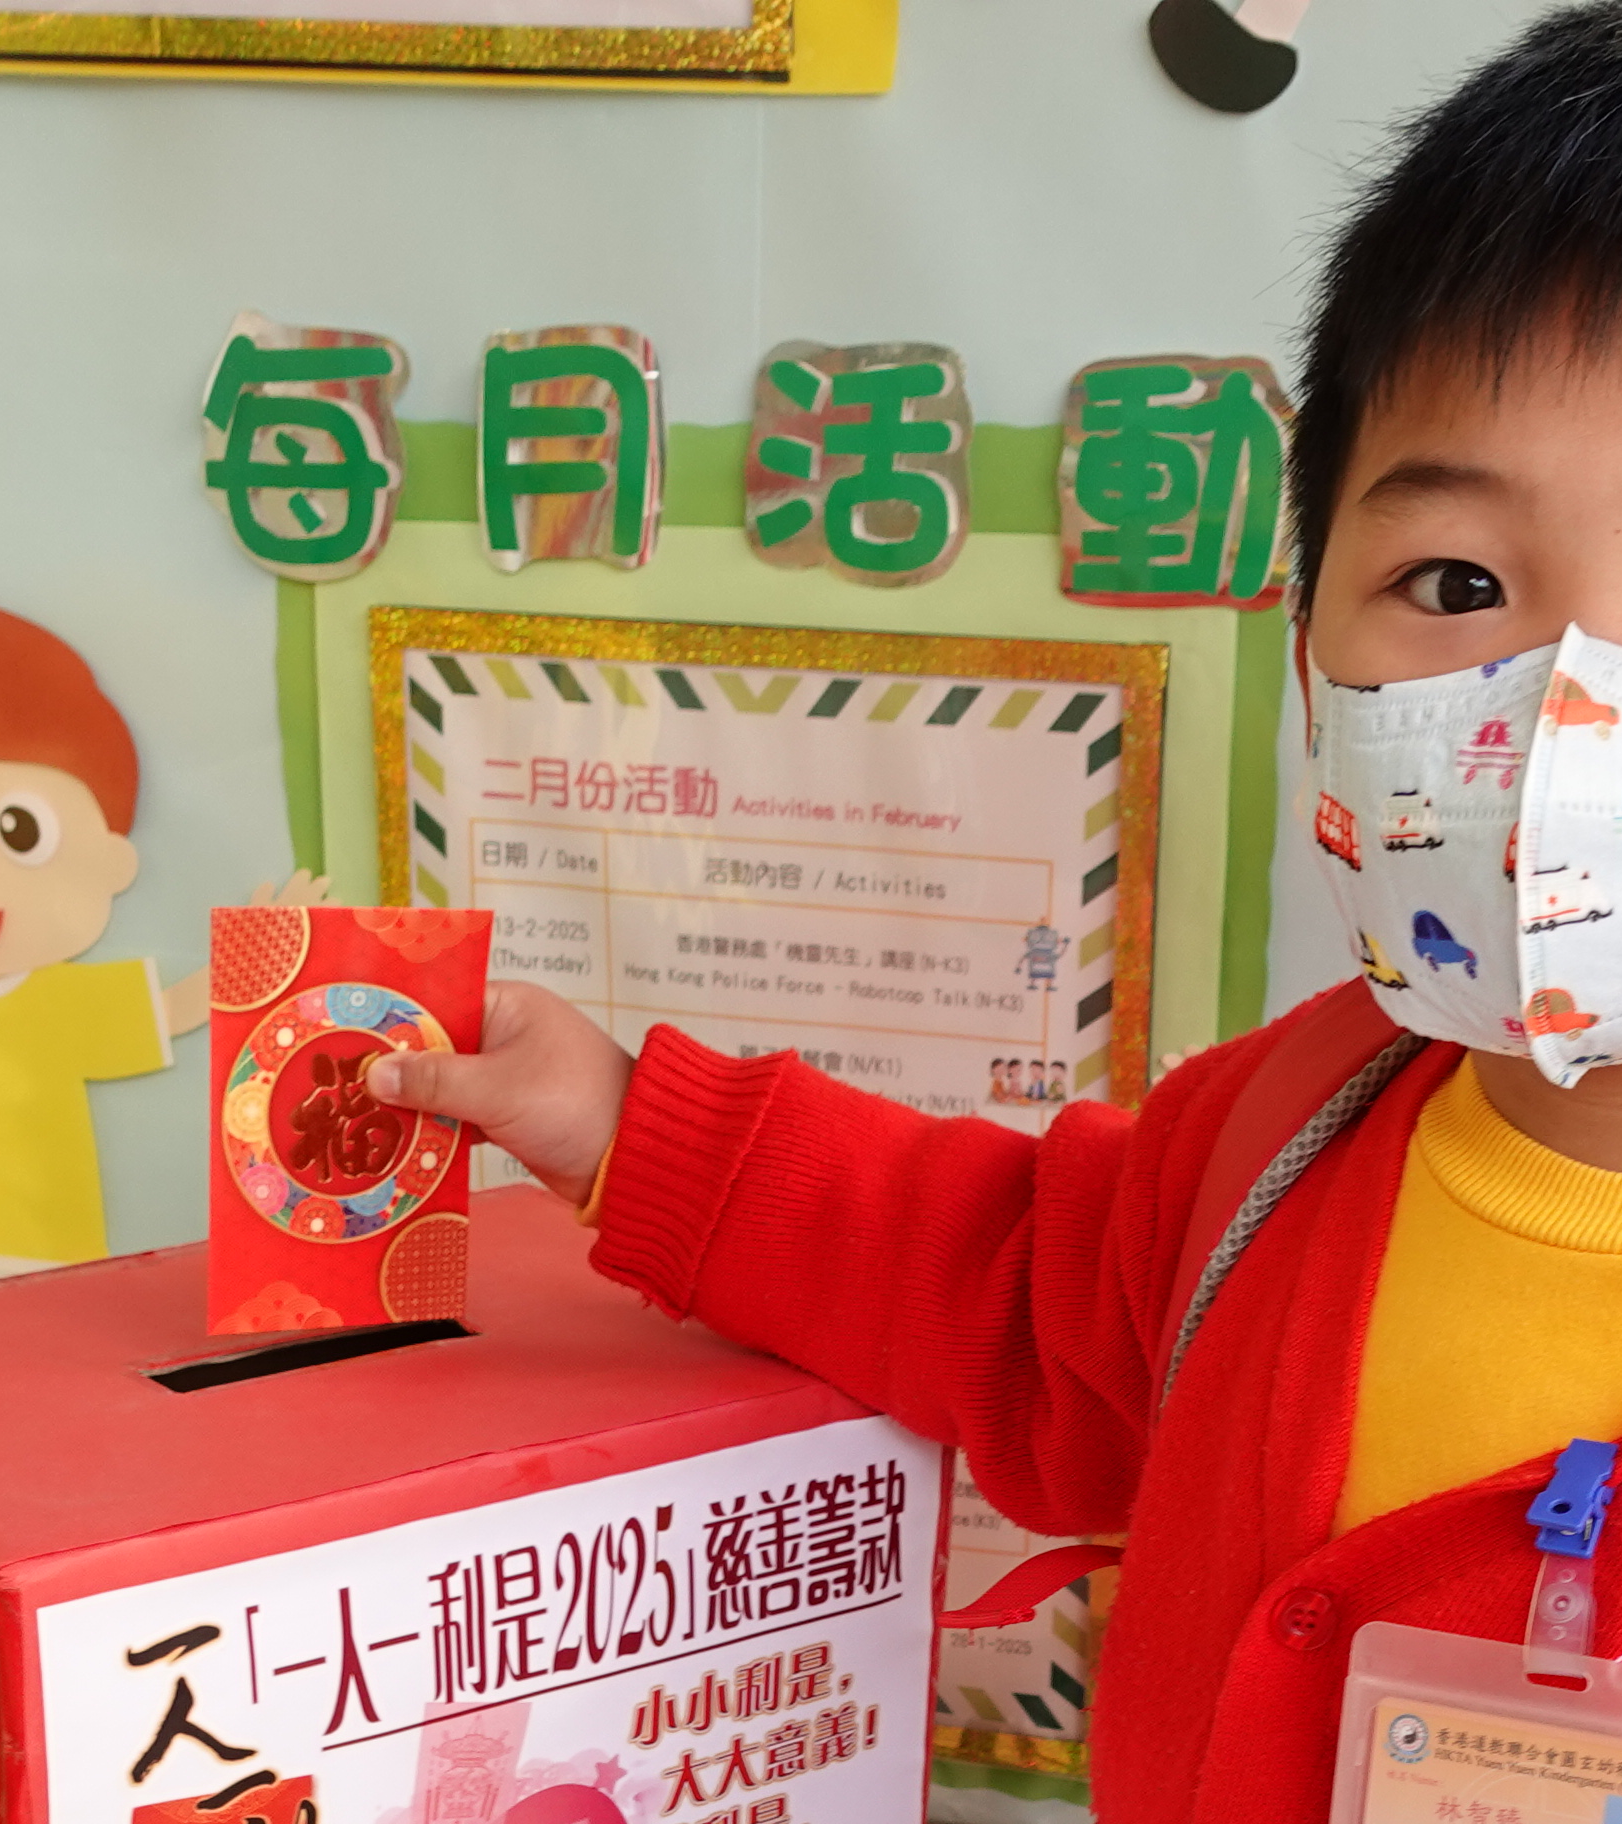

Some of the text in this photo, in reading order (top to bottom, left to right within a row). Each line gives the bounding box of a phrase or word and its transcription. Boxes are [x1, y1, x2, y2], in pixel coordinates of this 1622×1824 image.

[204, 334, 1282, 598] 每月活動
[483, 756, 963, 832] 二月份活動 Activities in February
[482, 840, 527, 868] 日期
[556, 848, 599, 874] Date
[705, 857, 803, 891] 活動內容
[835, 870, 947, 900] Activities
[493, 915, 590, 942] 13-2-2025
[492, 947, 593, 976] (Thursday)
[712, 969, 769, 992] Police
[777, 974, 825, 995] Force
[1538, 1766, 1615, 1790] Kindergarten
